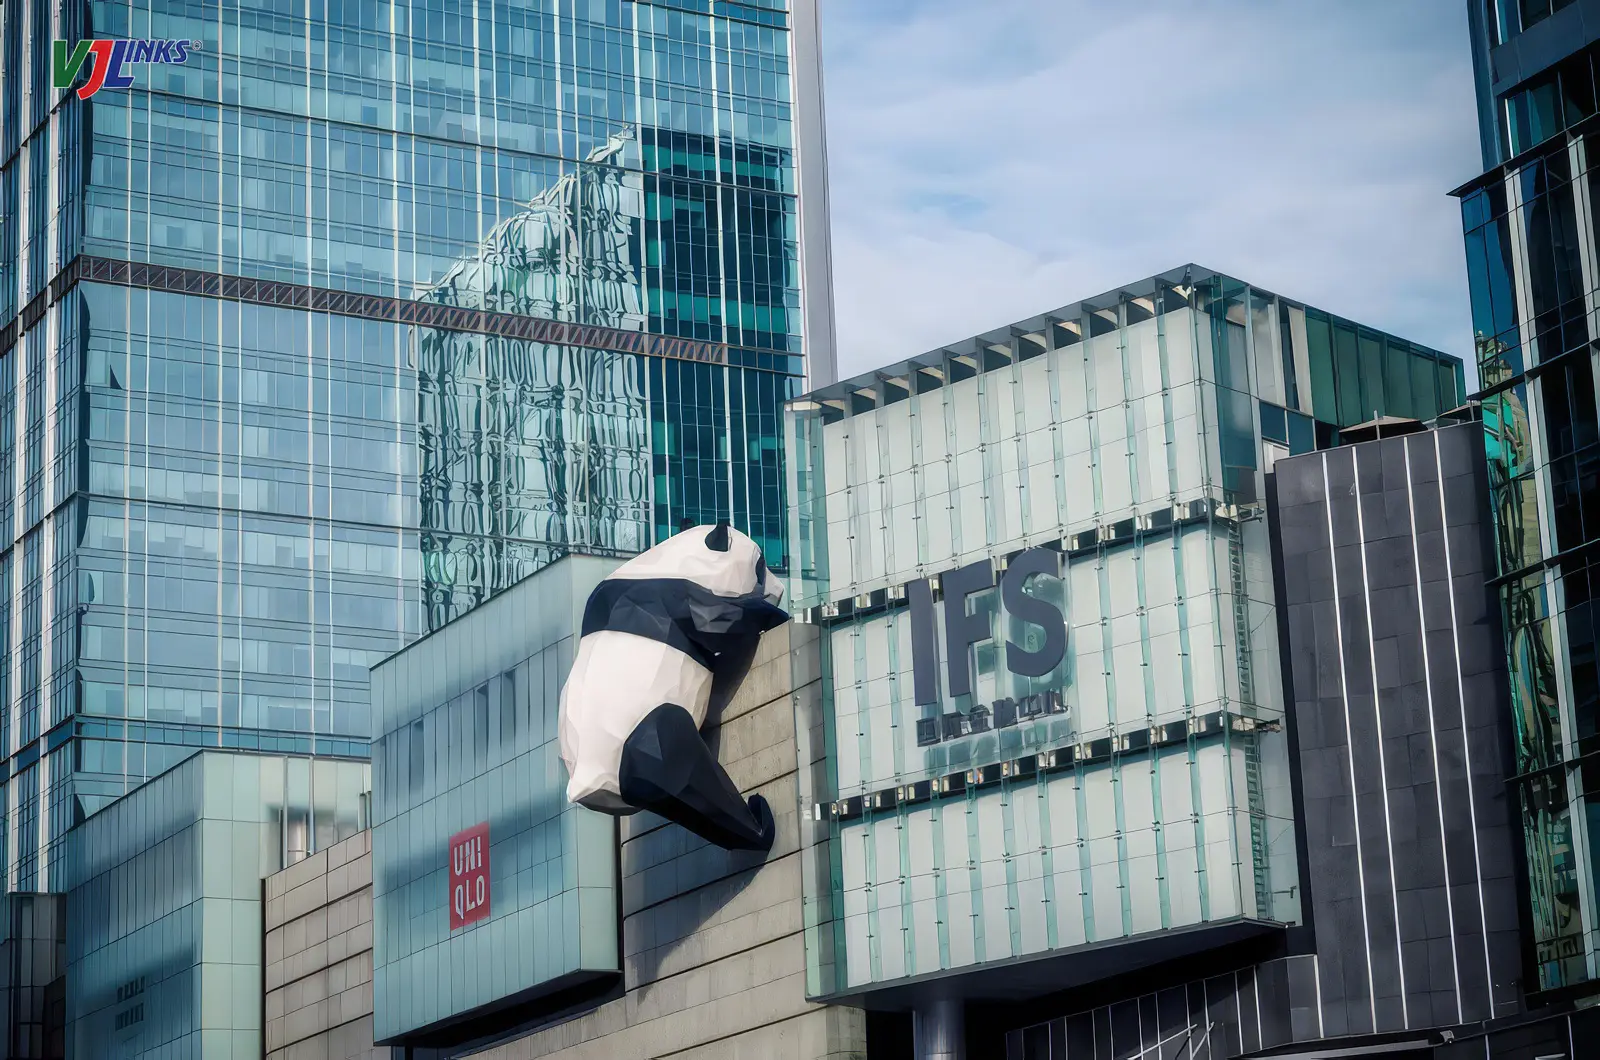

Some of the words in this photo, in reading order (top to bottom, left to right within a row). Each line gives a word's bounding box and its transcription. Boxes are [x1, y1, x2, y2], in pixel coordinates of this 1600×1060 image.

[908, 546, 1068, 707] IFS
[453, 836, 482, 876] UNI
[455, 875, 485, 920] QLO
